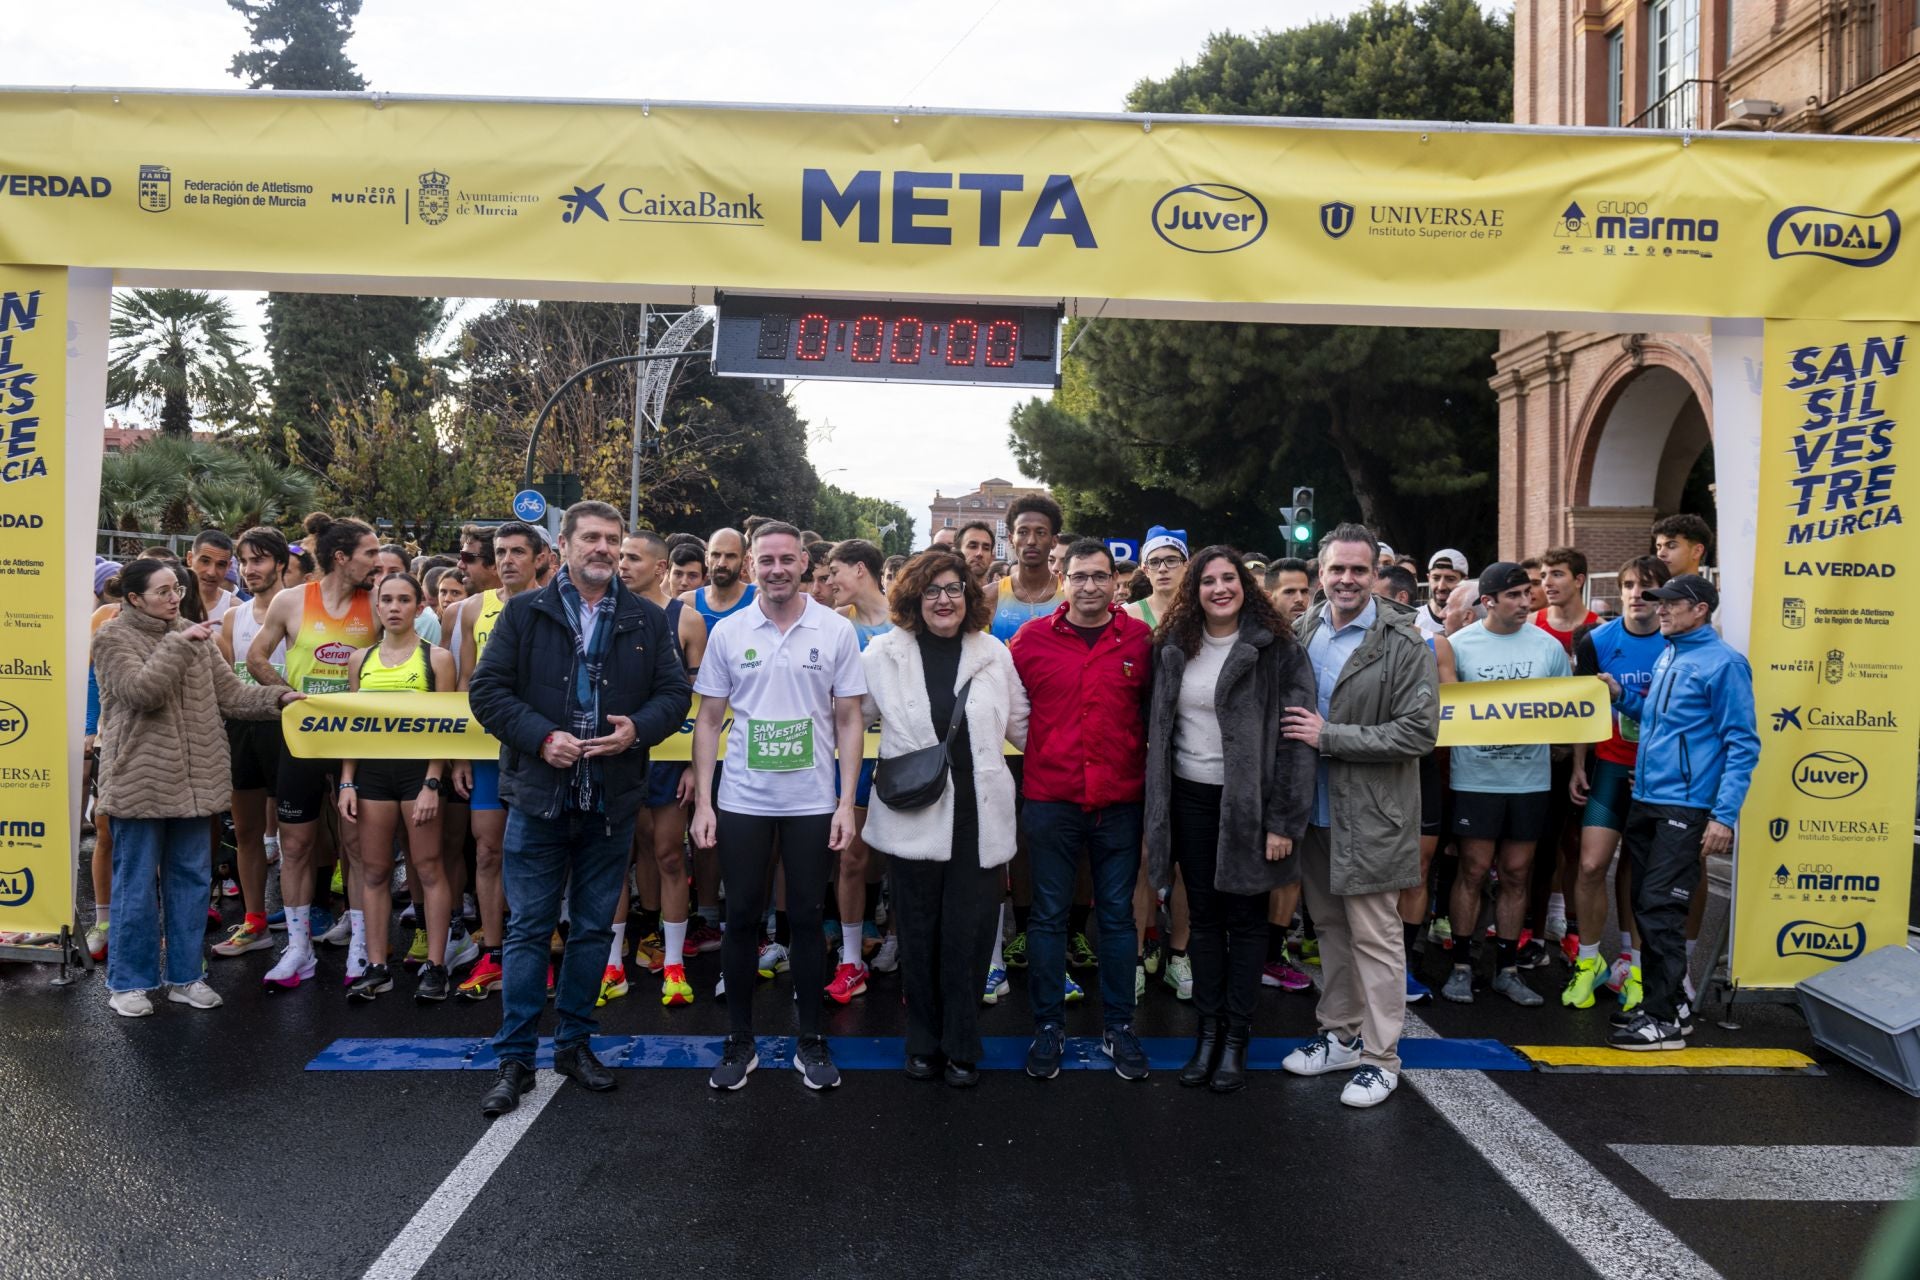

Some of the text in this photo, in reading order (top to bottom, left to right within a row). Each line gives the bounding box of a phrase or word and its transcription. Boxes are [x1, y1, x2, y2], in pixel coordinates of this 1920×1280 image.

[184, 180, 313, 194] Federación de Atletismo
[184, 193, 306, 207] de la Región de Murcia
[331, 193, 396, 205] MURCIA
[456, 191, 539, 204] Ayuntamiento
[619, 187, 764, 220] CaixaBank
[456, 204, 518, 216] de Murcia
[801, 168, 1098, 249] META
[1369, 206, 1504, 227] UNIVERSAE
[1596, 200, 1649, 217] Grupo
[1164, 205, 1255, 232] Juver
[1369, 226, 1503, 240] Instituto Superior de FP
[1596, 216, 1719, 242] marmo
[1789, 222, 1883, 249] VIDAL
[1784, 335, 1908, 389] SAN
[1801, 380, 1885, 431] SIL
[1786, 420, 1897, 473] VES
[1786, 464, 1897, 517] TRE
[1785, 504, 1902, 545] MURCIA
[12, 559, 44, 567] Atletismo
[1784, 561, 1896, 578] LA VERDAD
[4, 611, 54, 620] Ayuntamiento
[1814, 607, 1848, 616] Federación
[1860, 608, 1894, 617] Atletismo
[15, 620, 41, 628] Murcia
[1831, 616, 1852, 625] Región
[1854, 617, 1863, 625] de
[1864, 617, 1890, 625] Murcia
[319, 649, 351, 660] Serran
[740, 660, 763, 669] megar
[1477, 661, 1532, 680] SAN
[1770, 664, 1814, 672] MURCIA
[1847, 661, 1903, 671] Ayuntamiento
[1859, 671, 1888, 679] Murcia
[308, 680, 329, 688] SAN
[299, 716, 469, 733] SAN SILVESTRE
[1808, 707, 1898, 728] CaixaBank
[753, 722, 775, 733] SAN
[753, 720, 808, 742] SILVESTRE
[757, 740, 803, 757] 3576
[1799, 765, 1860, 784] Juver
[1799, 819, 1889, 834] UNIVERSAE
[1831, 834, 1864, 842] Superior
[1865, 834, 1876, 842] de
[1797, 863, 1833, 873] Grupo
[1797, 874, 1880, 891] marmo
[1790, 932, 1853, 950] VIDAL
